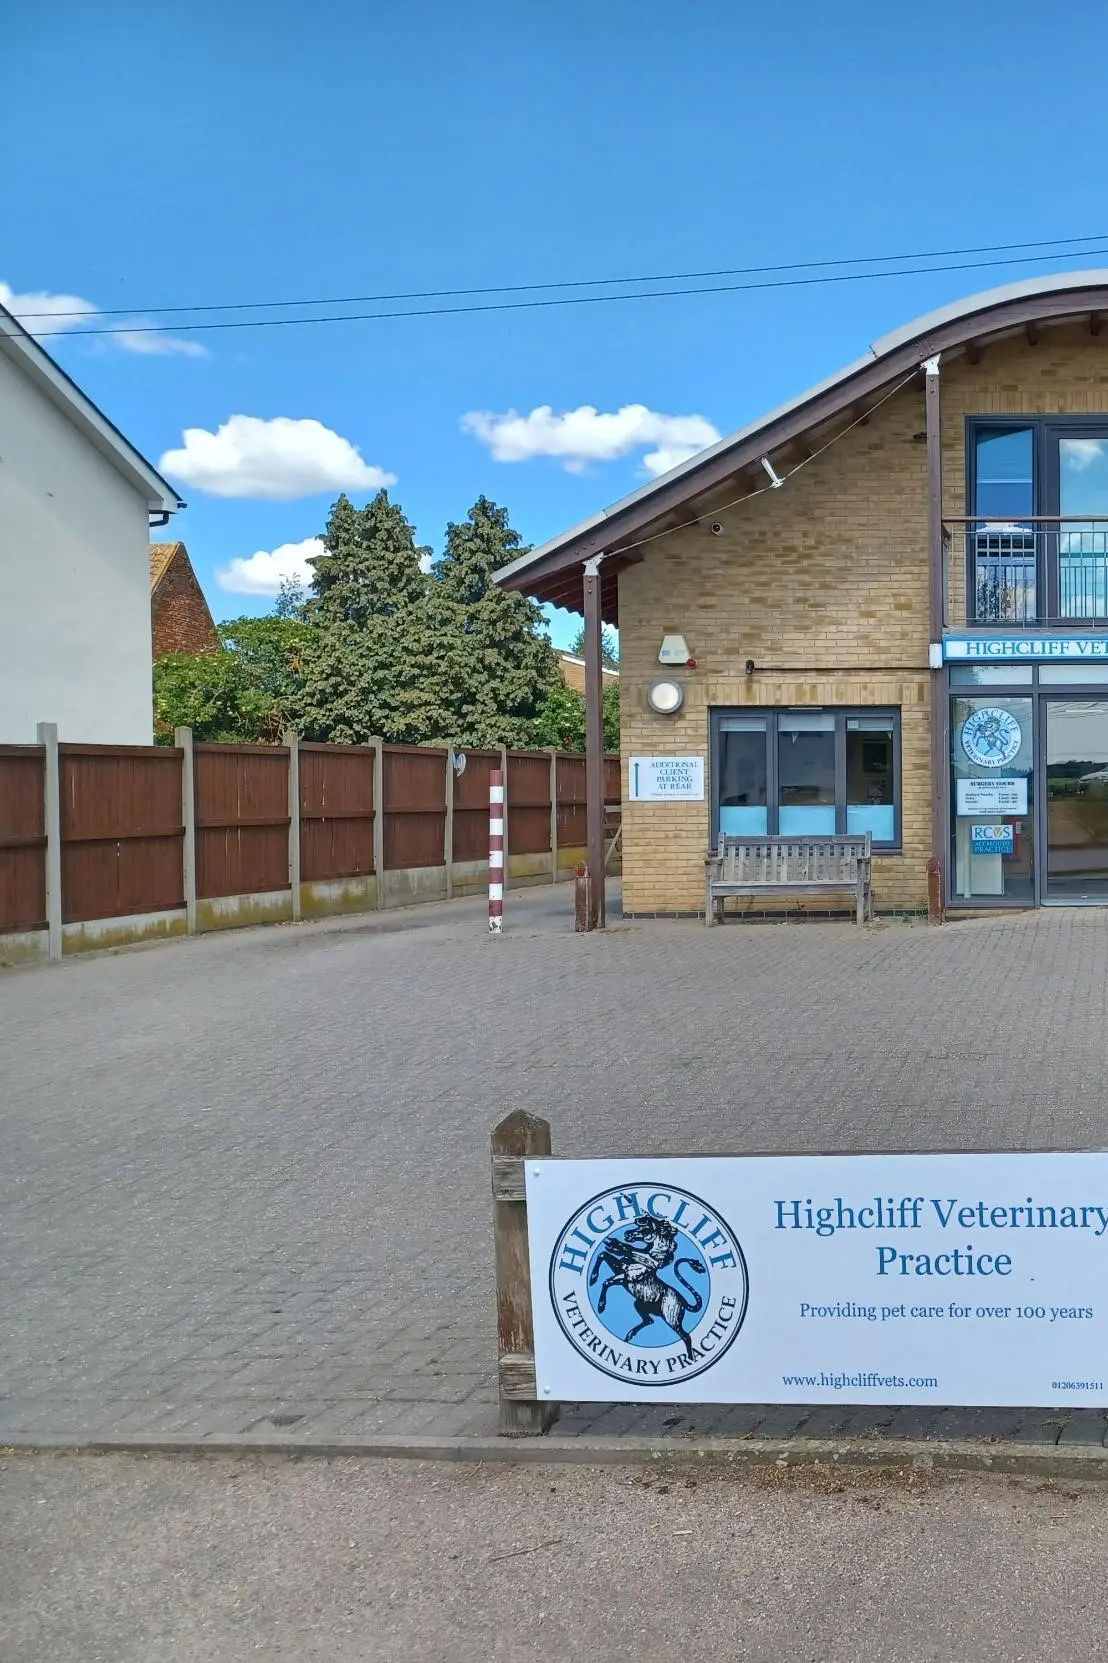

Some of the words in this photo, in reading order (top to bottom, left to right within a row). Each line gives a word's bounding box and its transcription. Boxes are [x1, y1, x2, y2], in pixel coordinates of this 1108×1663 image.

[966, 641, 1070, 655] HIGHCLIFF
[974, 826, 1010, 839] RCVS
[774, 1197, 924, 1235] Highcliff
[559, 1191, 737, 1276] HIGHCLIFF
[876, 1245, 1013, 1276] Practice
[799, 1301, 877, 1321] Providing
[881, 1304, 907, 1321] pet
[910, 1307, 943, 1318] care
[948, 1302, 972, 1318] for
[976, 1307, 1012, 1318] over
[1016, 1306, 1046, 1319] 100
[1049, 1307, 1093, 1322] years
[563, 1290, 660, 1375] VETERINARY
[666, 1296, 736, 1373] PRACTICE
[781, 1372, 938, 1390] www.highcliffvets.com
[1051, 1381, 1104, 1390] 01206391511
